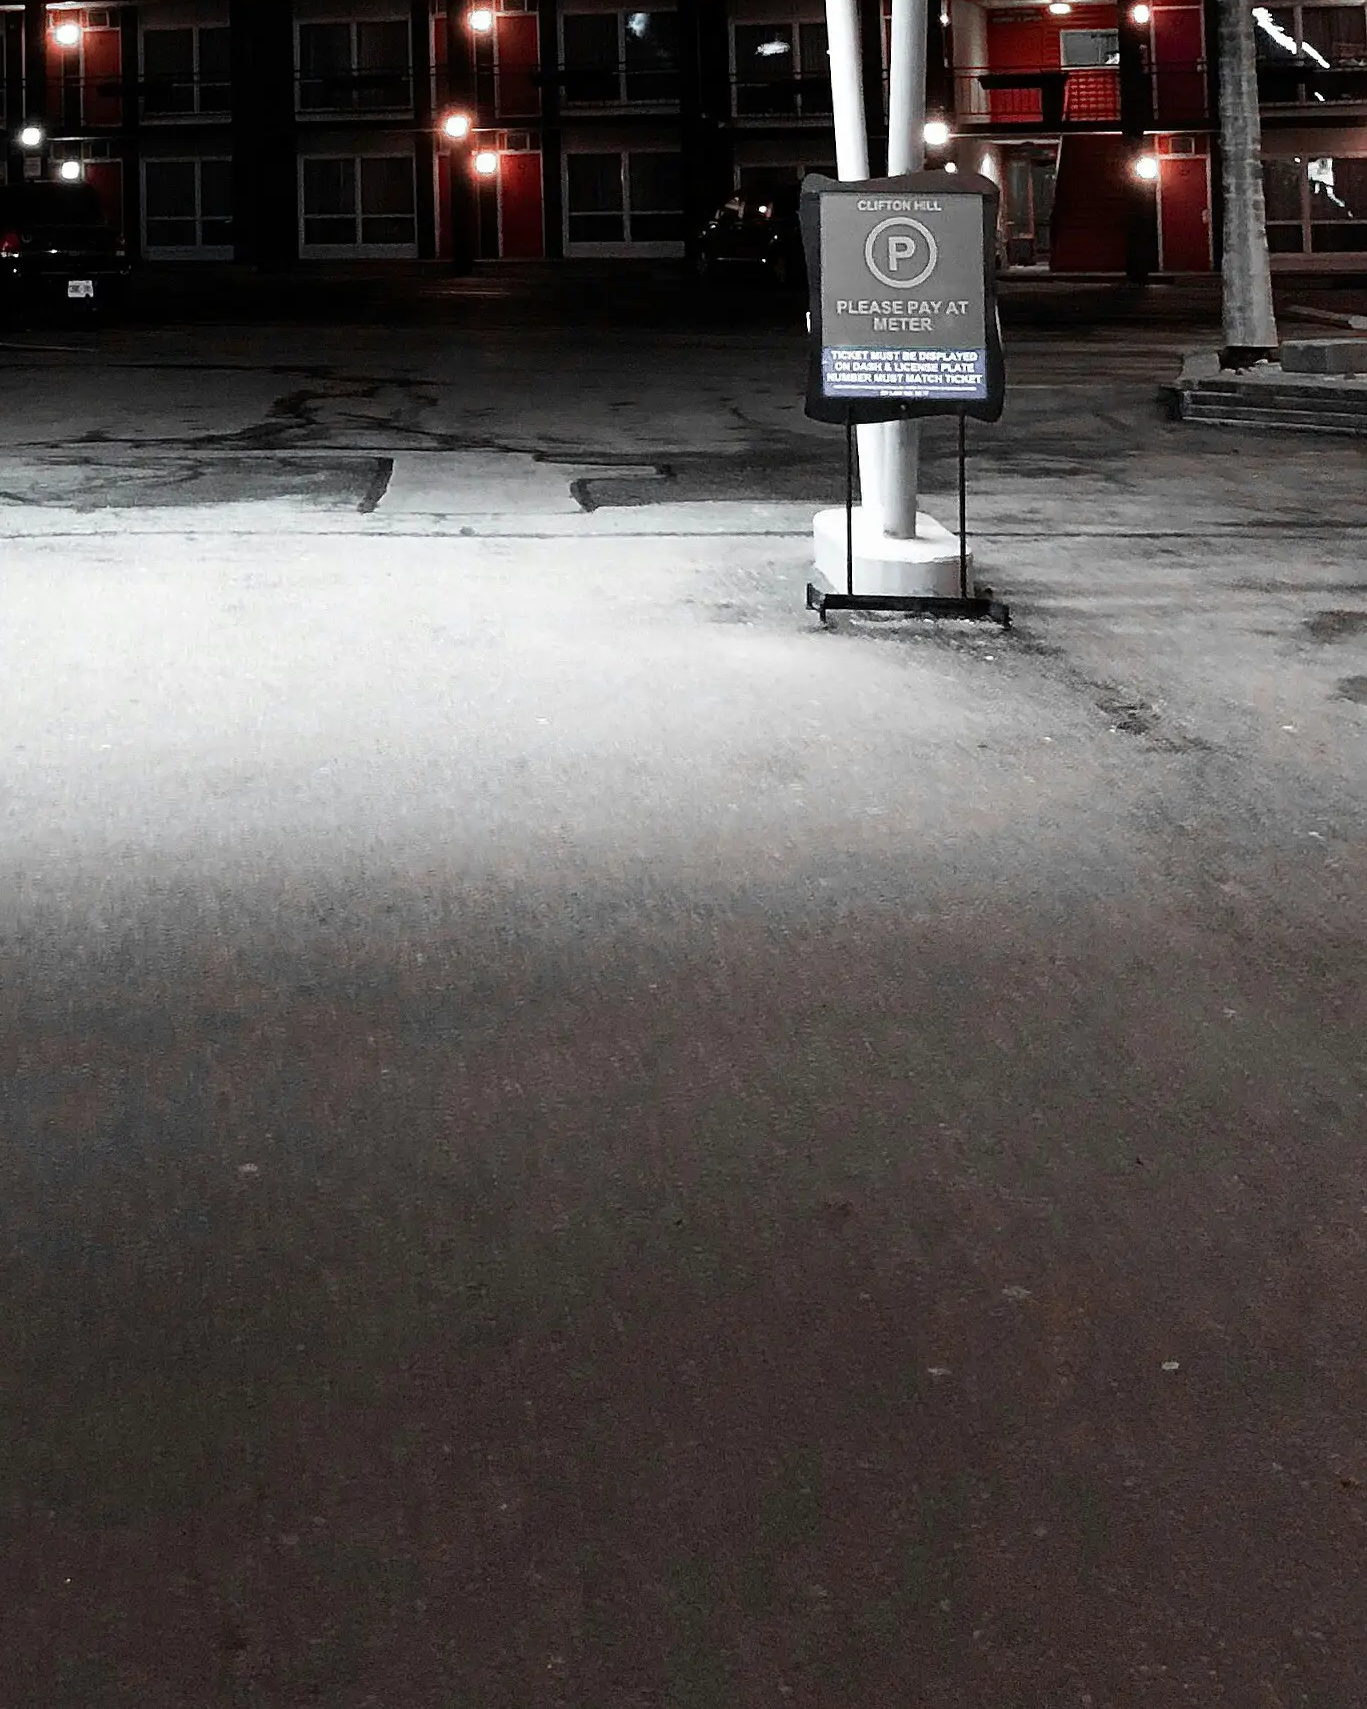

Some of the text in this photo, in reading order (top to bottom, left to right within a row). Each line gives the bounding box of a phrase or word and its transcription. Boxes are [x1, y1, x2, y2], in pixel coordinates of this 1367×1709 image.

[857, 199, 942, 212] CLIFTON HILL
[888, 236, 916, 271] P
[836, 300, 970, 315] PLEASE PAY AT
[873, 317, 934, 331] METER
[832, 351, 978, 361] TICKET MUST BE DISPLAYED
[835, 362, 975, 373] ON DASH & LICENSE PLATE
[827, 373, 982, 384] NUMBER MUST MATCH TICKET
